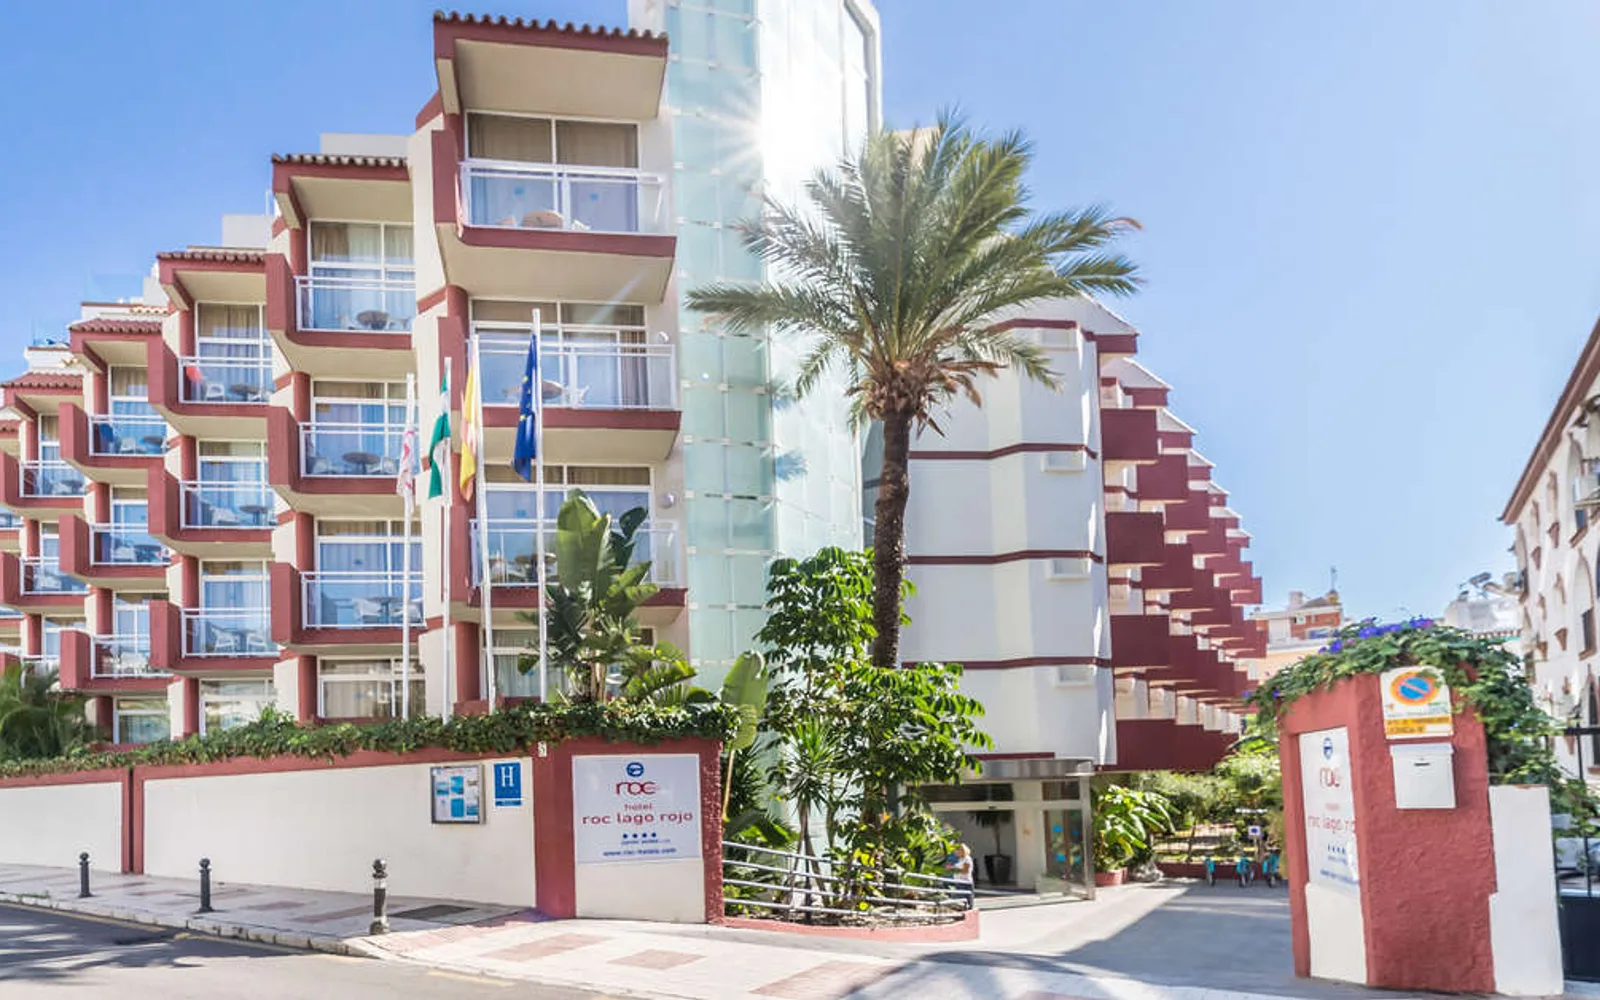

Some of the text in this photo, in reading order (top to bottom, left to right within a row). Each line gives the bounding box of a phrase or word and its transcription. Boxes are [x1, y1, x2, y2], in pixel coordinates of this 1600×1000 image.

[501, 766, 515, 787] H
[616, 781, 657, 795] roc
[582, 812, 693, 826] roc lago rojo
